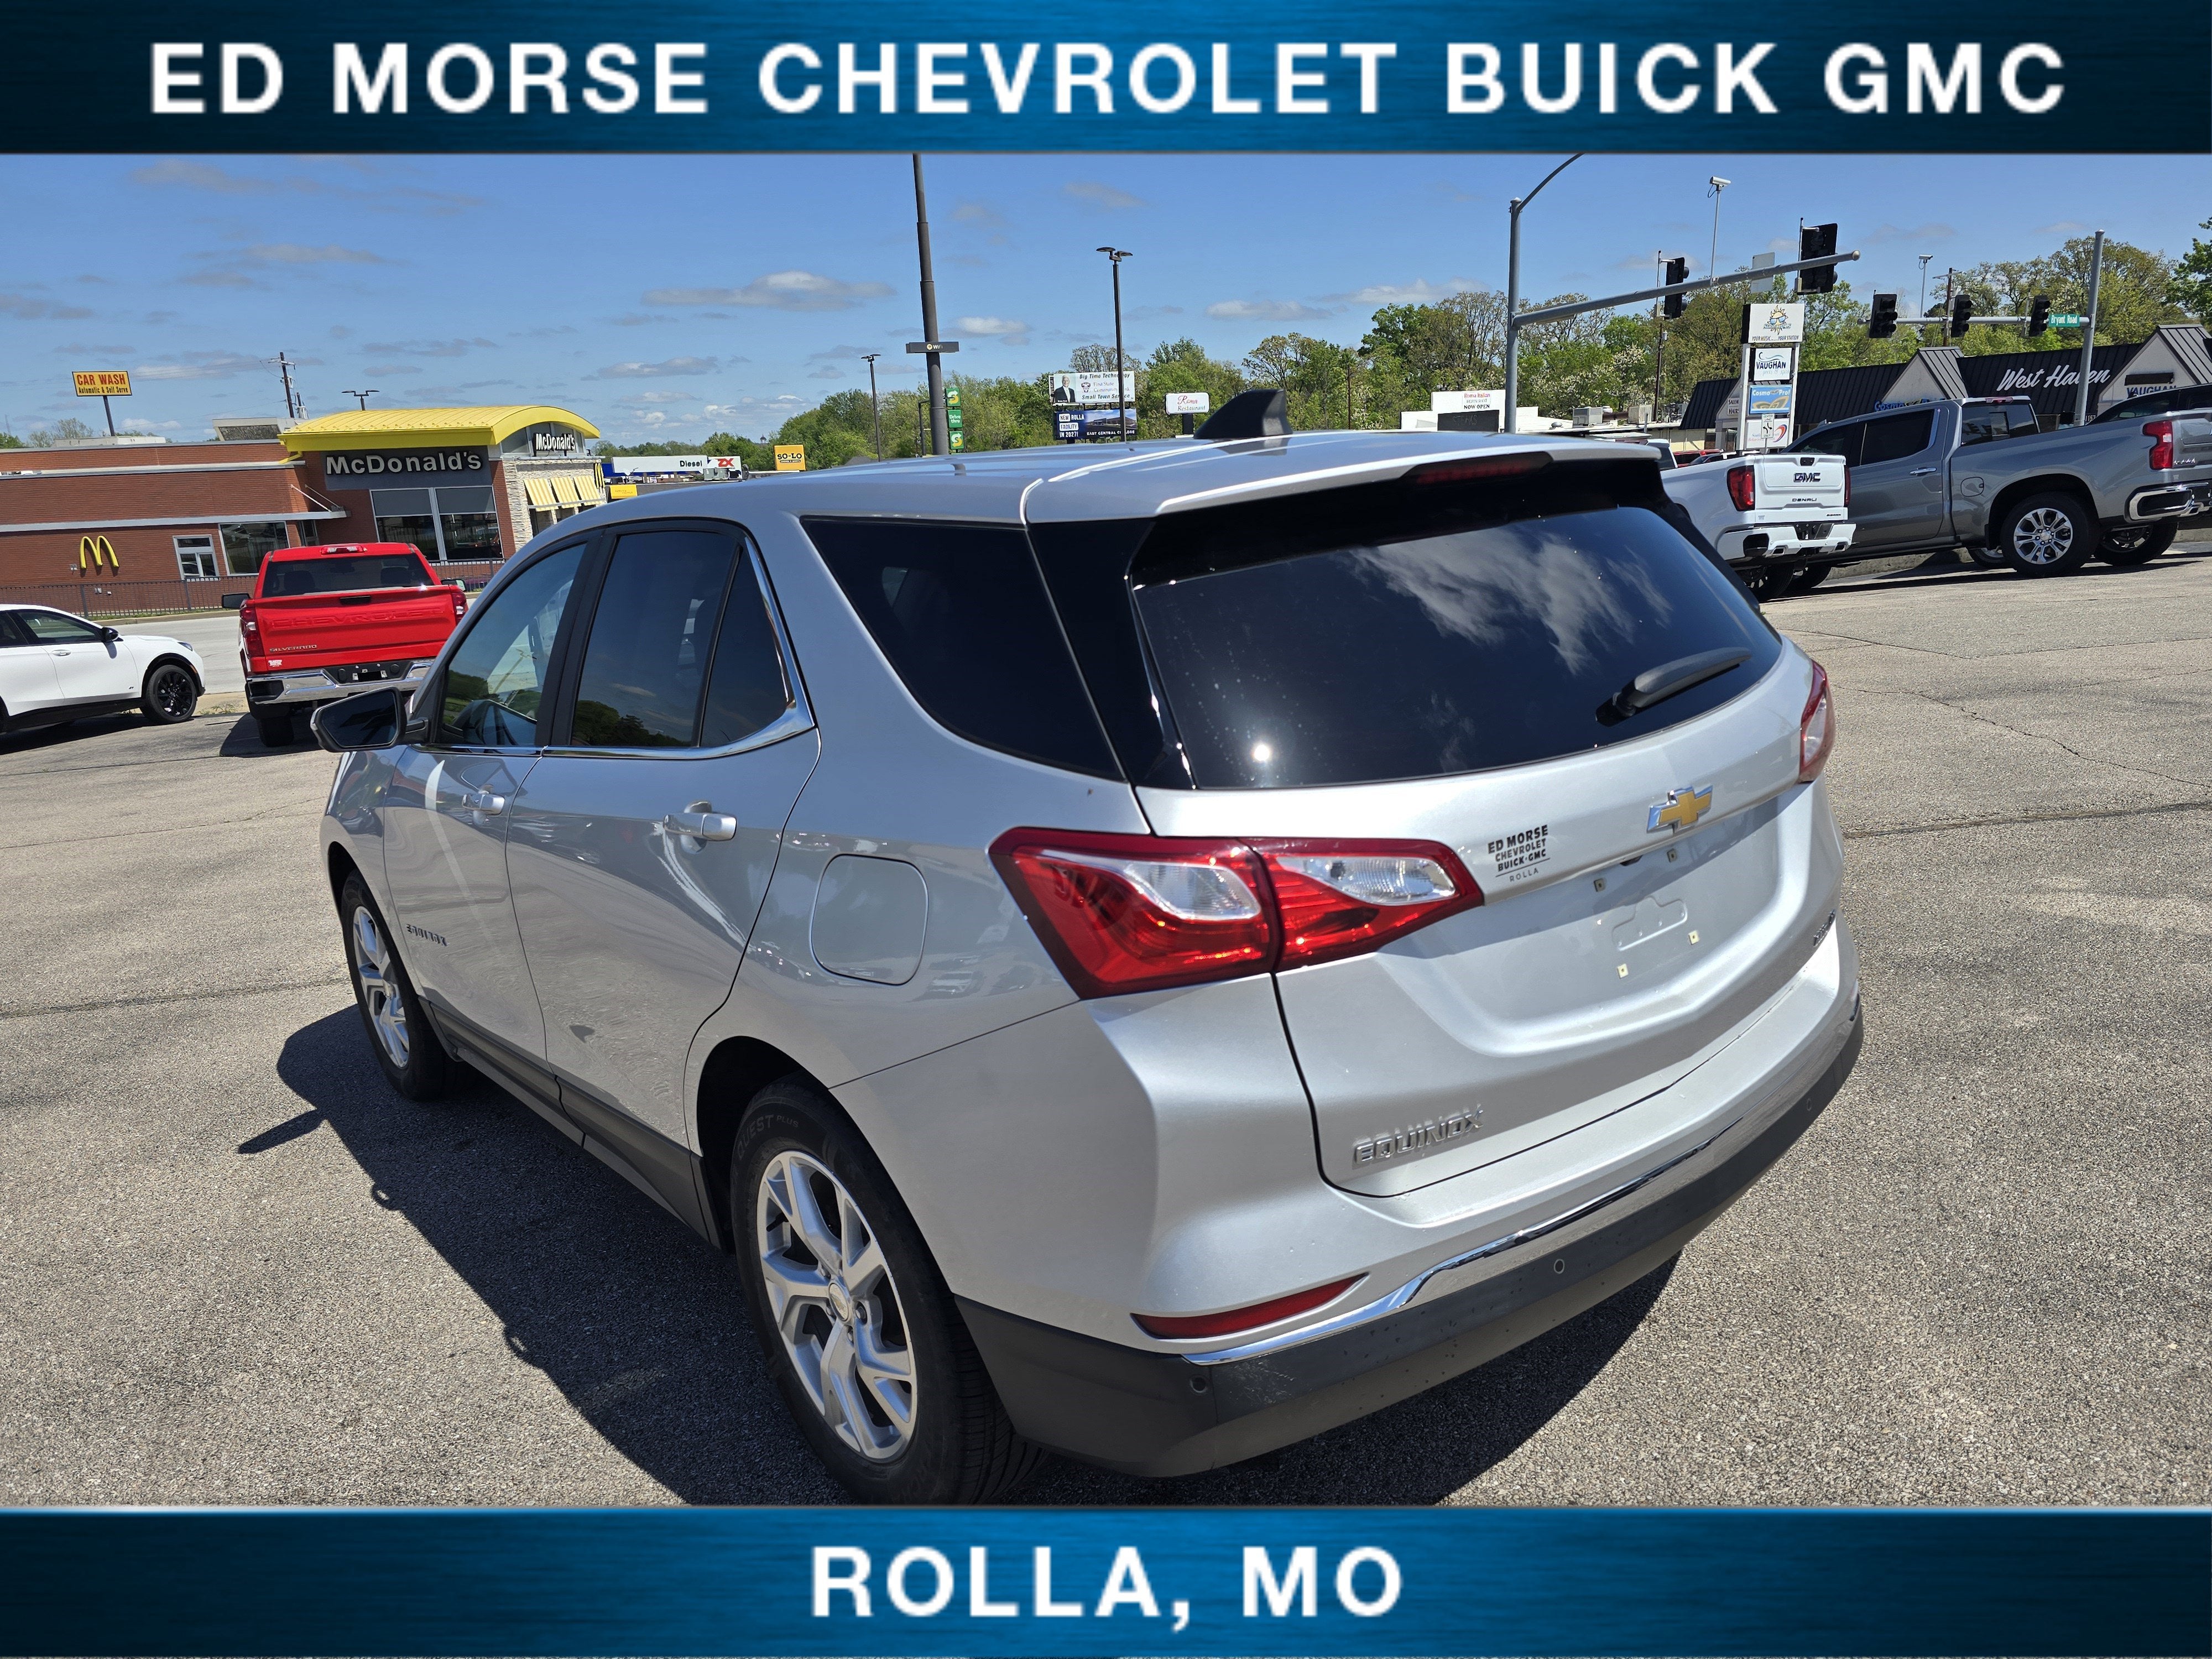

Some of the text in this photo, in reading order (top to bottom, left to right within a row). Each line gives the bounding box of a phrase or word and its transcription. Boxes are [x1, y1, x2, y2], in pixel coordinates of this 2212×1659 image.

[2051, 315, 2078, 326] Bryant Road
[1756, 361, 1786, 369] VAUGHAN
[76, 373, 126, 386] CAR WASH
[1996, 367, 2045, 392] West
[79, 386, 101, 394] Automatic
[535, 432, 576, 451] McDonald's
[326, 451, 482, 474] McDonald's
[679, 460, 703, 468] Diesel
[1793, 472, 1821, 483] GMC
[269, 644, 317, 653] SILVERADO
[1487, 824, 1549, 854] ED MORSE
[1495, 838, 1547, 862] CHEVROLET
[1509, 867, 1539, 883] ROLLA
[776, 1115, 800, 1129] PLUS
[1354, 1108, 1484, 1165] EQUINOX
